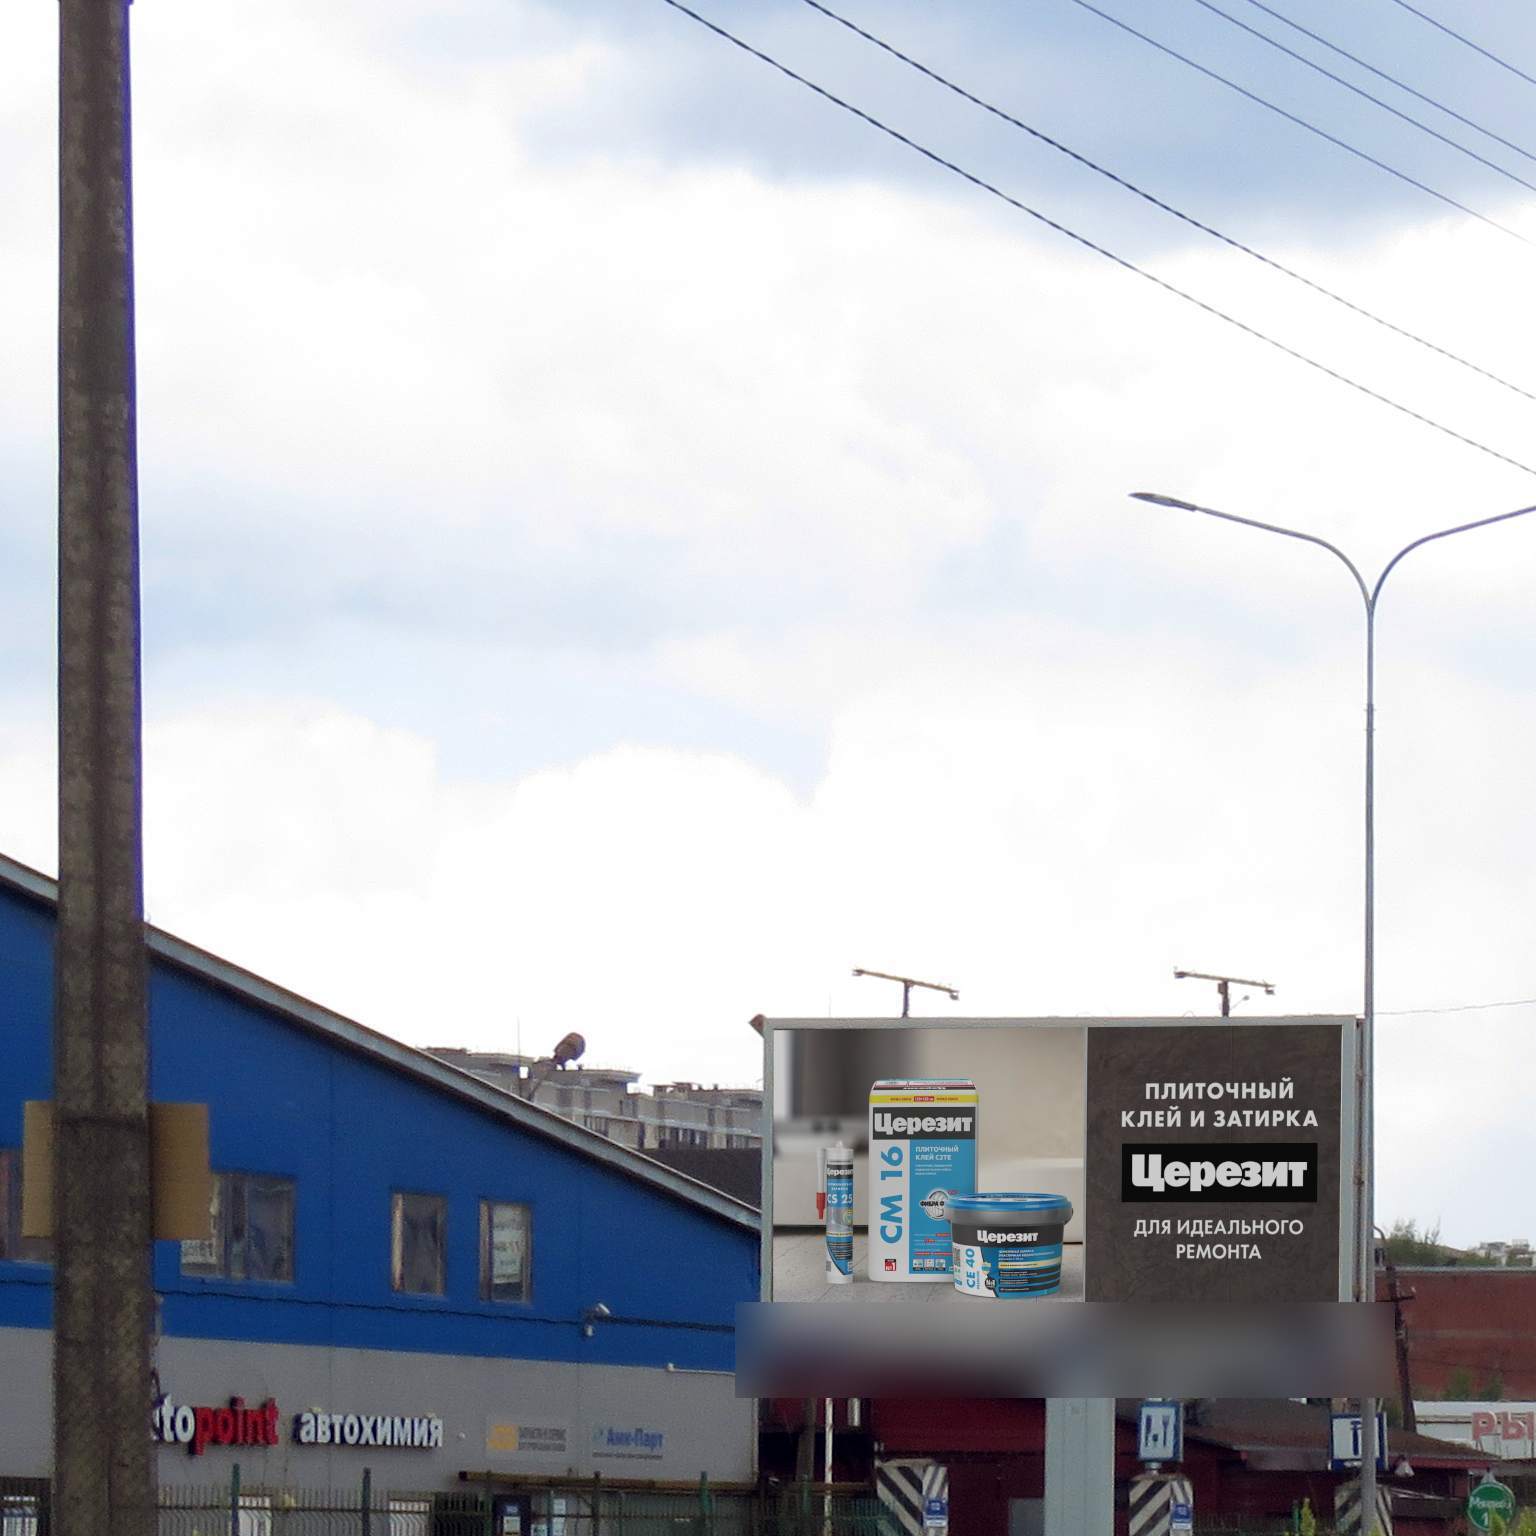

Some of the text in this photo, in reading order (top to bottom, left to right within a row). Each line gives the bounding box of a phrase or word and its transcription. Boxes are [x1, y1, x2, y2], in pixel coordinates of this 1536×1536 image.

[1145, 1077, 1294, 1100] ПЛИТОЧНЫЙ
[873, 1112, 973, 1136] Церезит
[1121, 1105, 1319, 1128] КЛЕЙ И ЗАТИРКА
[1131, 1153, 1308, 1192] Церезит
[976, 1229, 1039, 1244] Церезит
[1133, 1219, 1304, 1238] ДЛЯ ИДЕАЛЬНОГО
[1176, 1244, 1262, 1260] РЕМОНТА
[297, 1412, 443, 1448] автохимия
